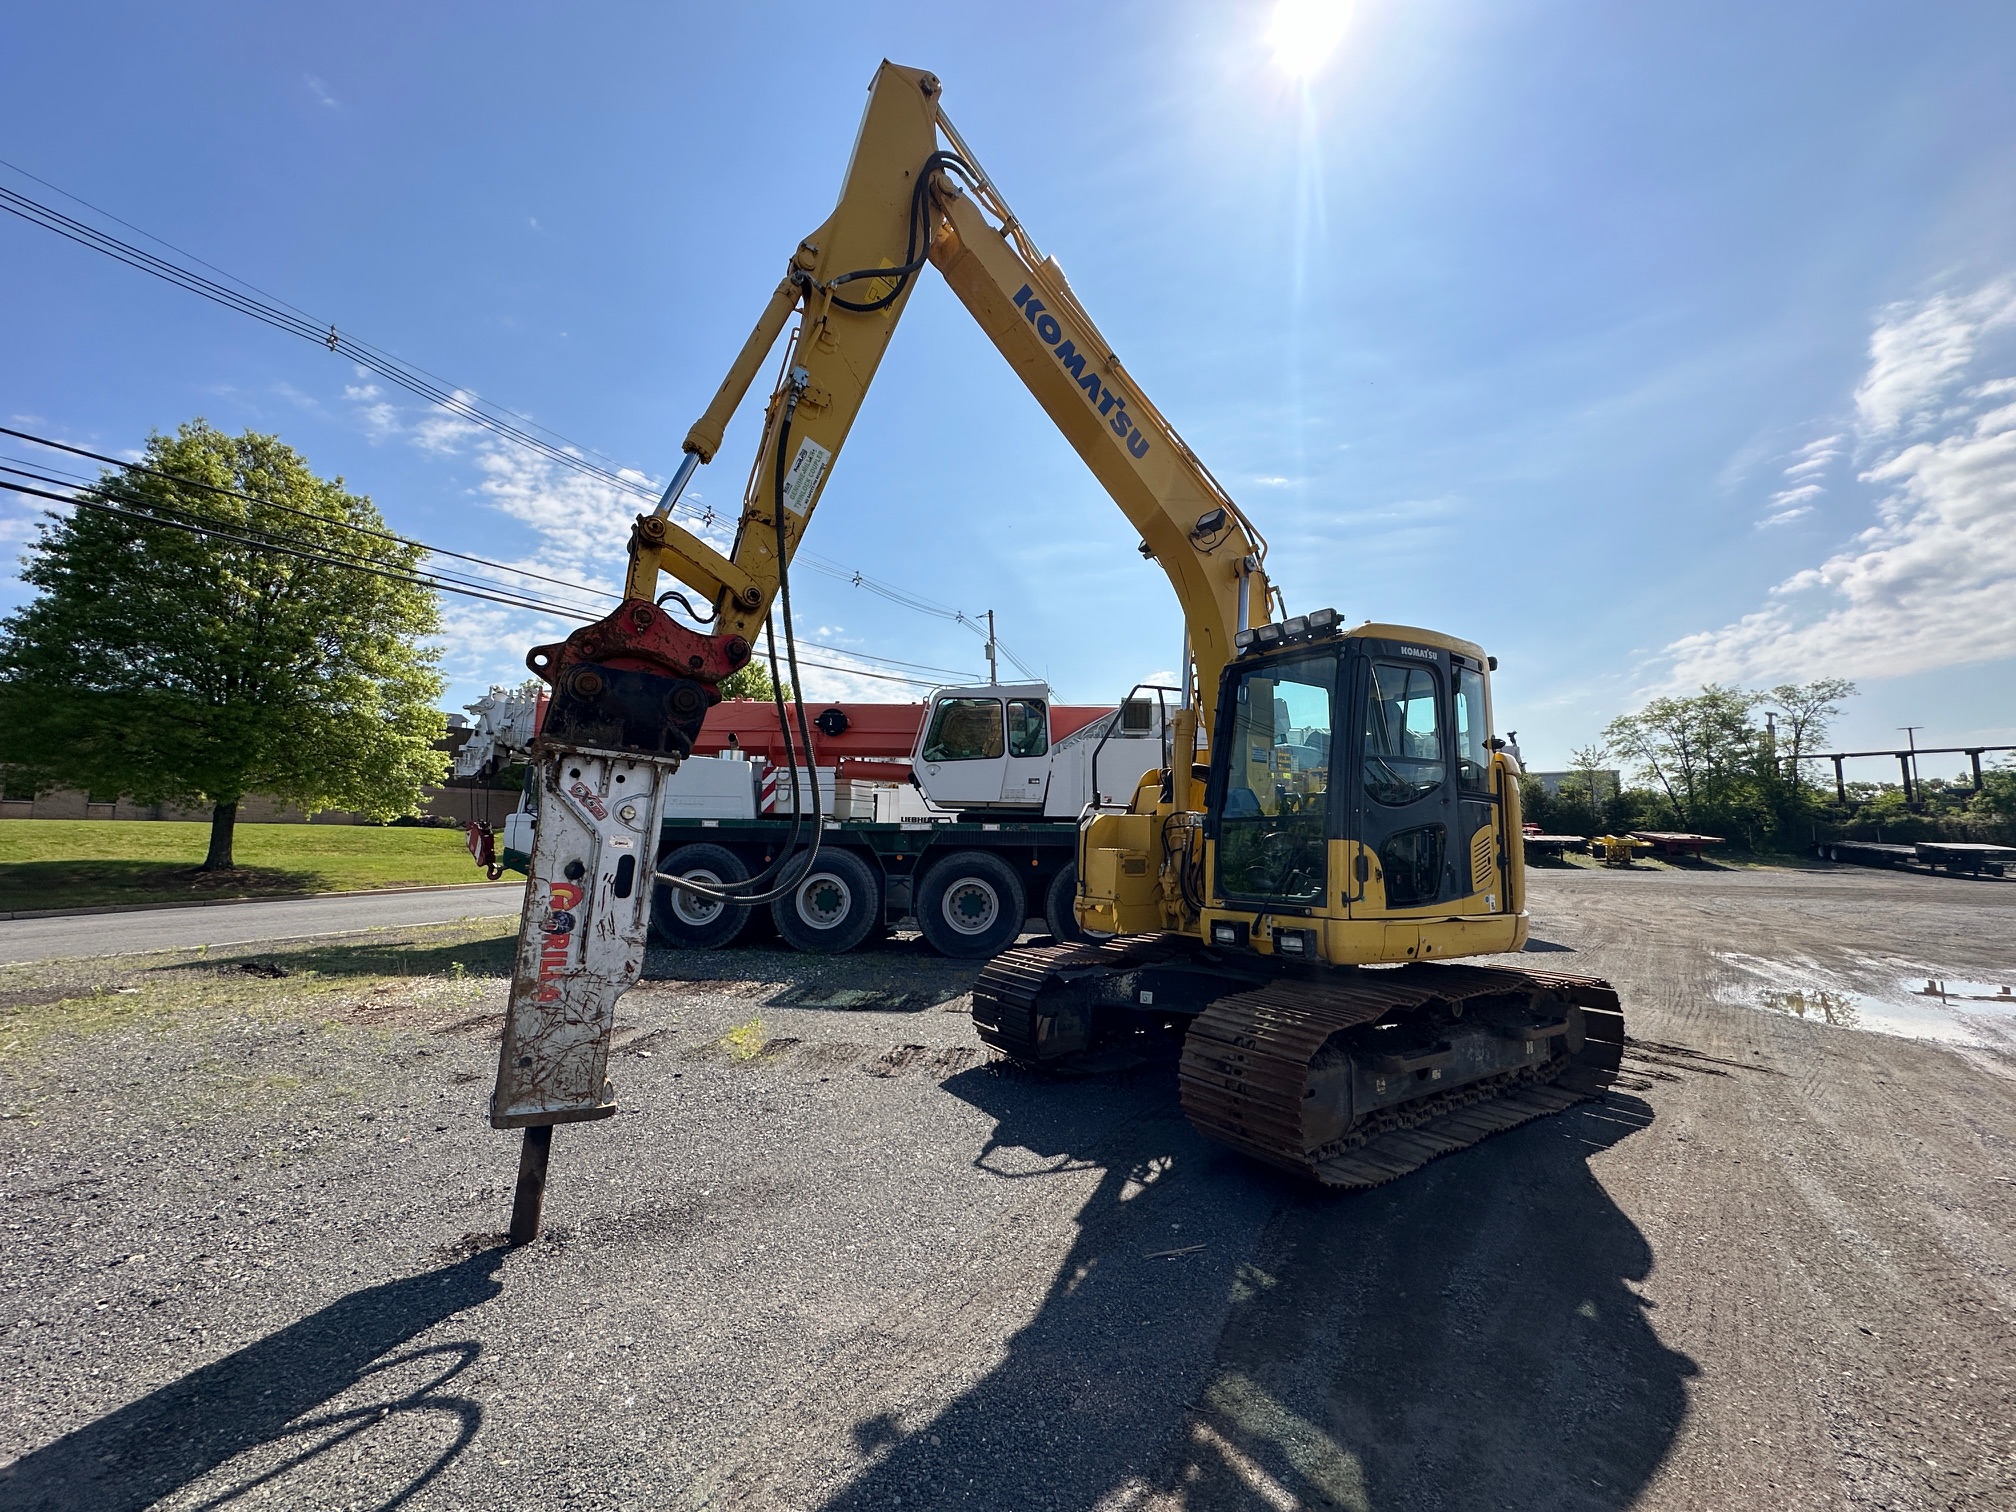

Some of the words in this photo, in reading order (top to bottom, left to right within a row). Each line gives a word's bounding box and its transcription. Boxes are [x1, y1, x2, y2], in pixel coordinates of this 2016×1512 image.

[1012, 283, 1150, 459] KOMATSU
[789, 472, 805, 500] GENUINE
[794, 477, 811, 508] TWINLOCK
[808, 450, 823, 477] COUPLER
[1400, 646, 1438, 660] KOMATSU
